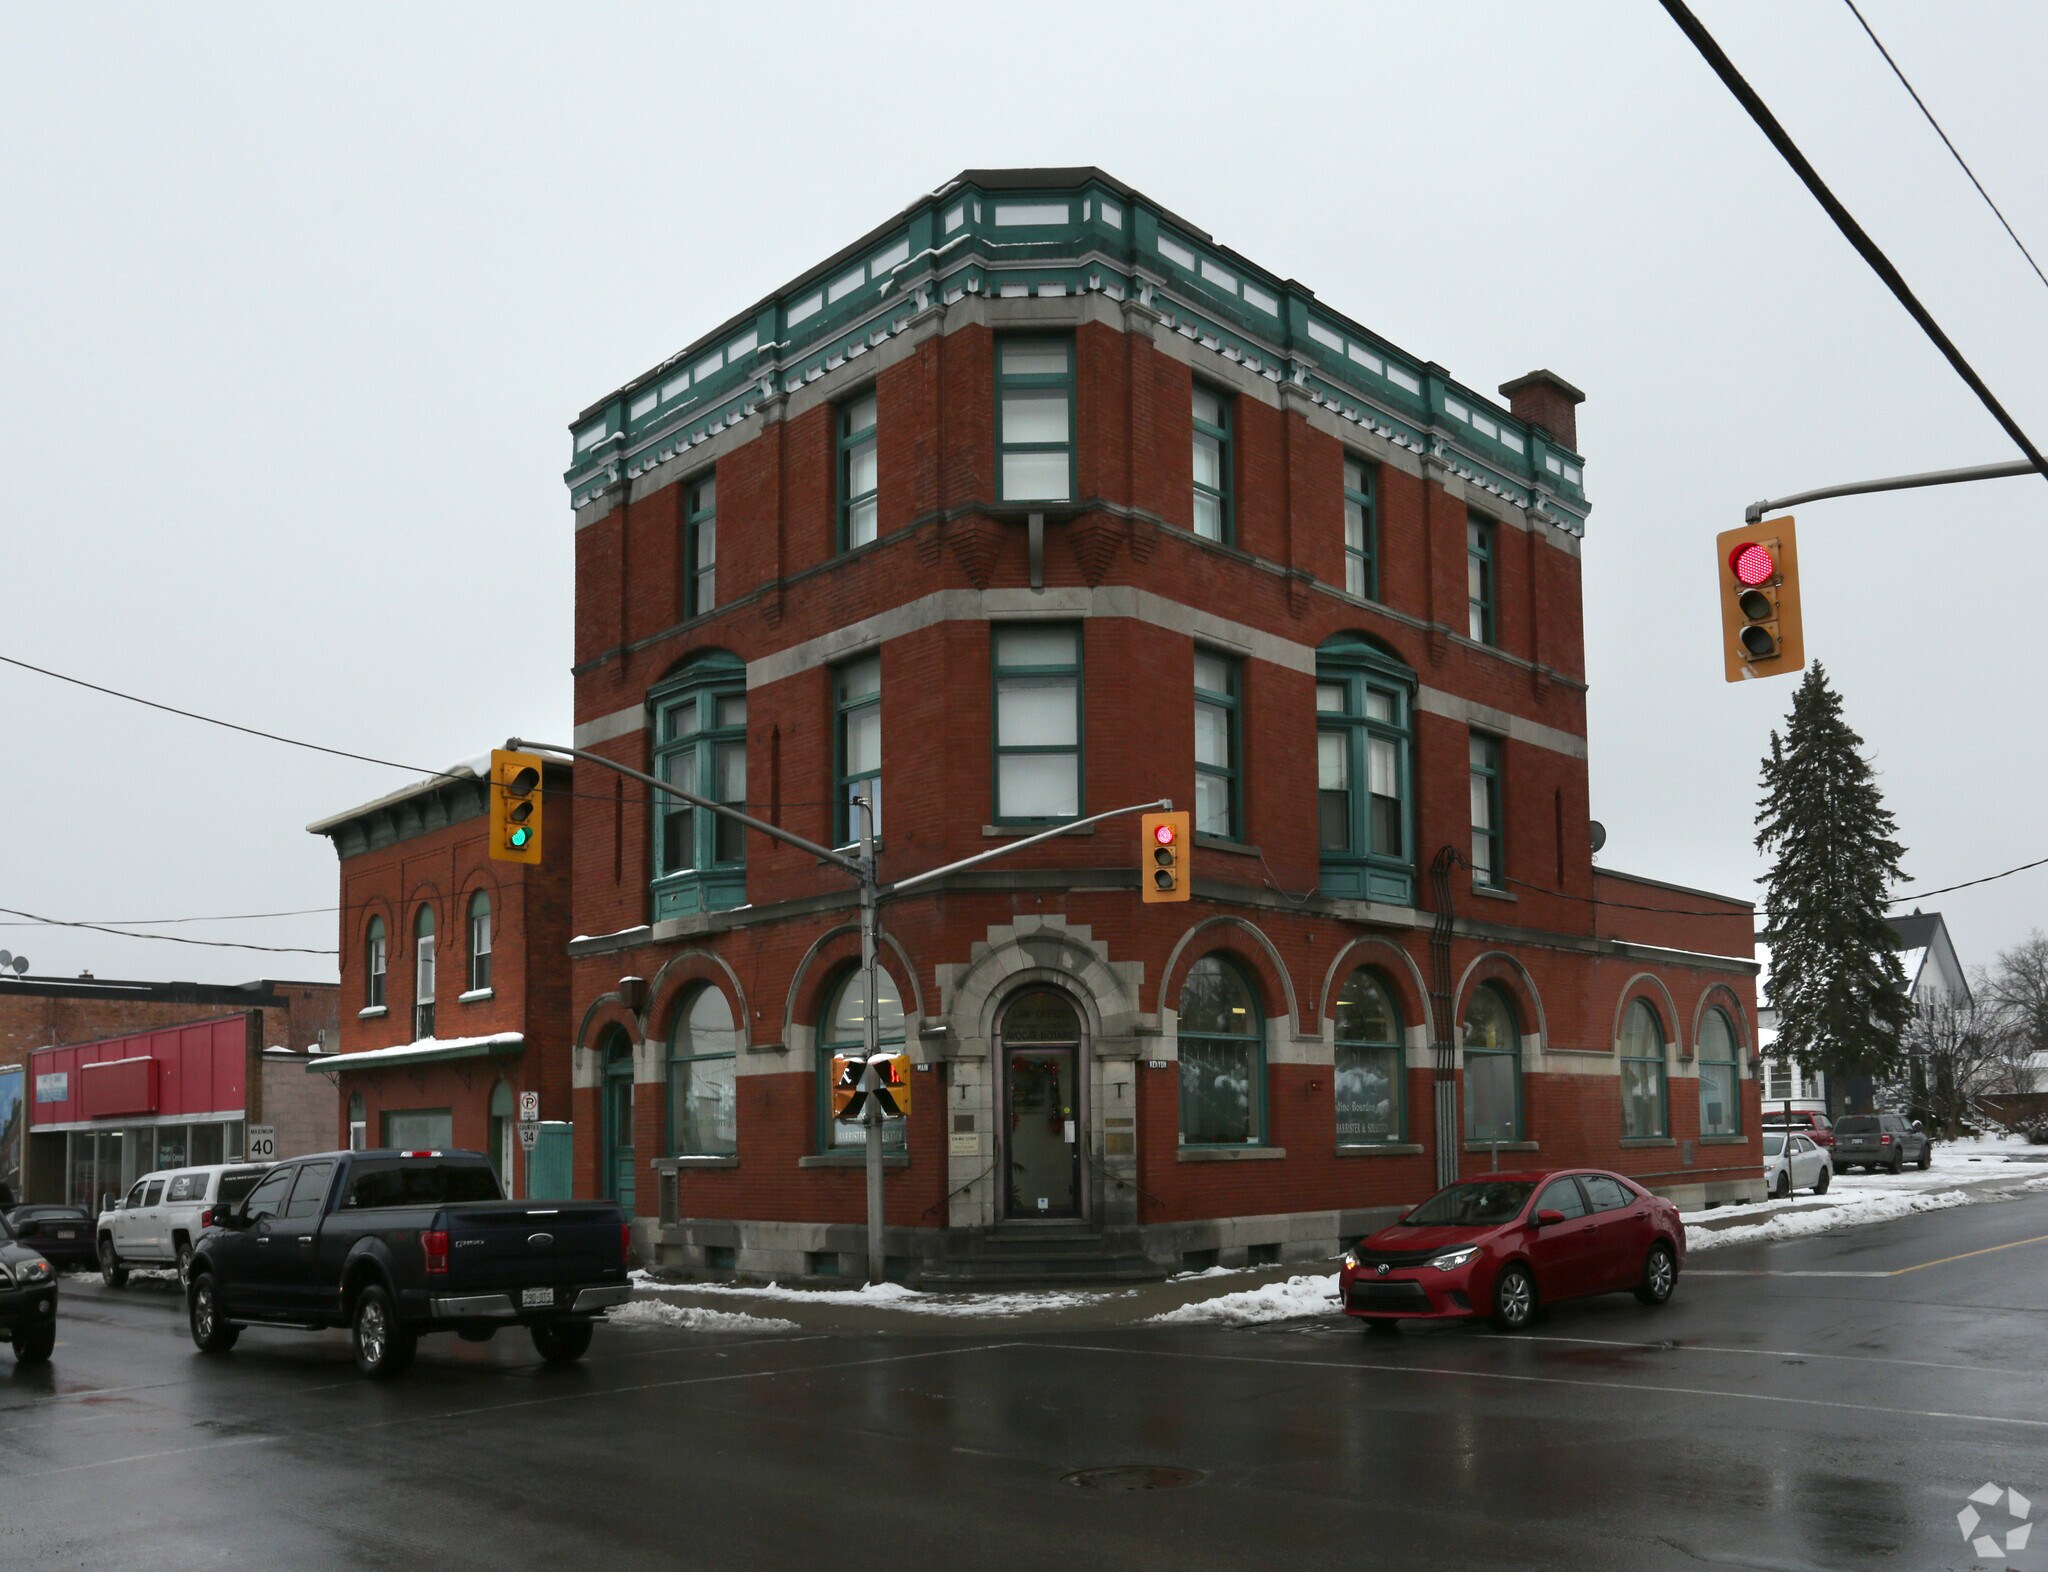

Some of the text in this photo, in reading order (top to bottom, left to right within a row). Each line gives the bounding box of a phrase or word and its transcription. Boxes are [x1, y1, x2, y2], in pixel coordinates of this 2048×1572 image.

[1012, 1008, 1032, 1019] LAW
[524, 1131, 534, 1142] 34
[251, 1139, 273, 1155] 40
